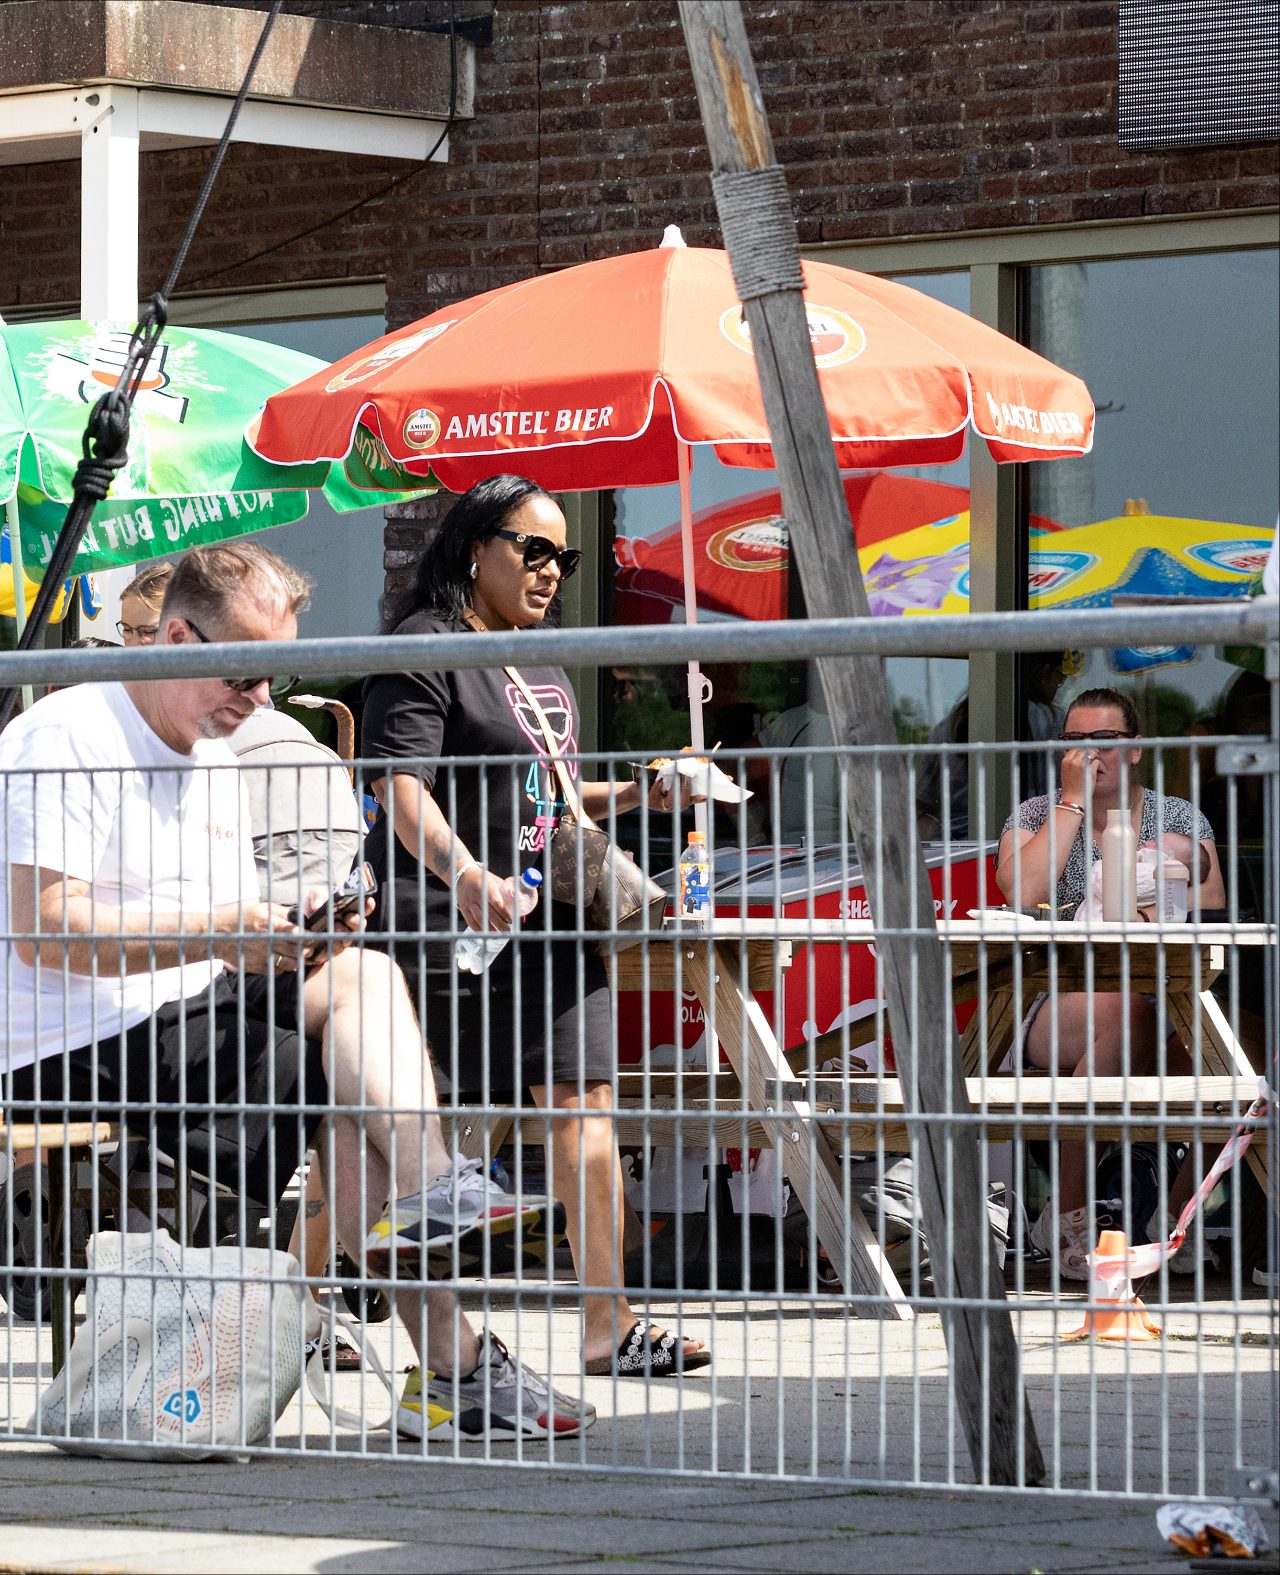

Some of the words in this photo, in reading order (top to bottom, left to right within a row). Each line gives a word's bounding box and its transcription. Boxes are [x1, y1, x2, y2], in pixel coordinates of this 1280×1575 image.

[409, 423, 433, 431] AMSTEL
[444, 411, 548, 440] AMSTEL
[554, 406, 614, 433] BIER
[1001, 402, 1040, 434] AMSTEL
[1039, 411, 1085, 434] BIER
[518, 825, 547, 852] KA
